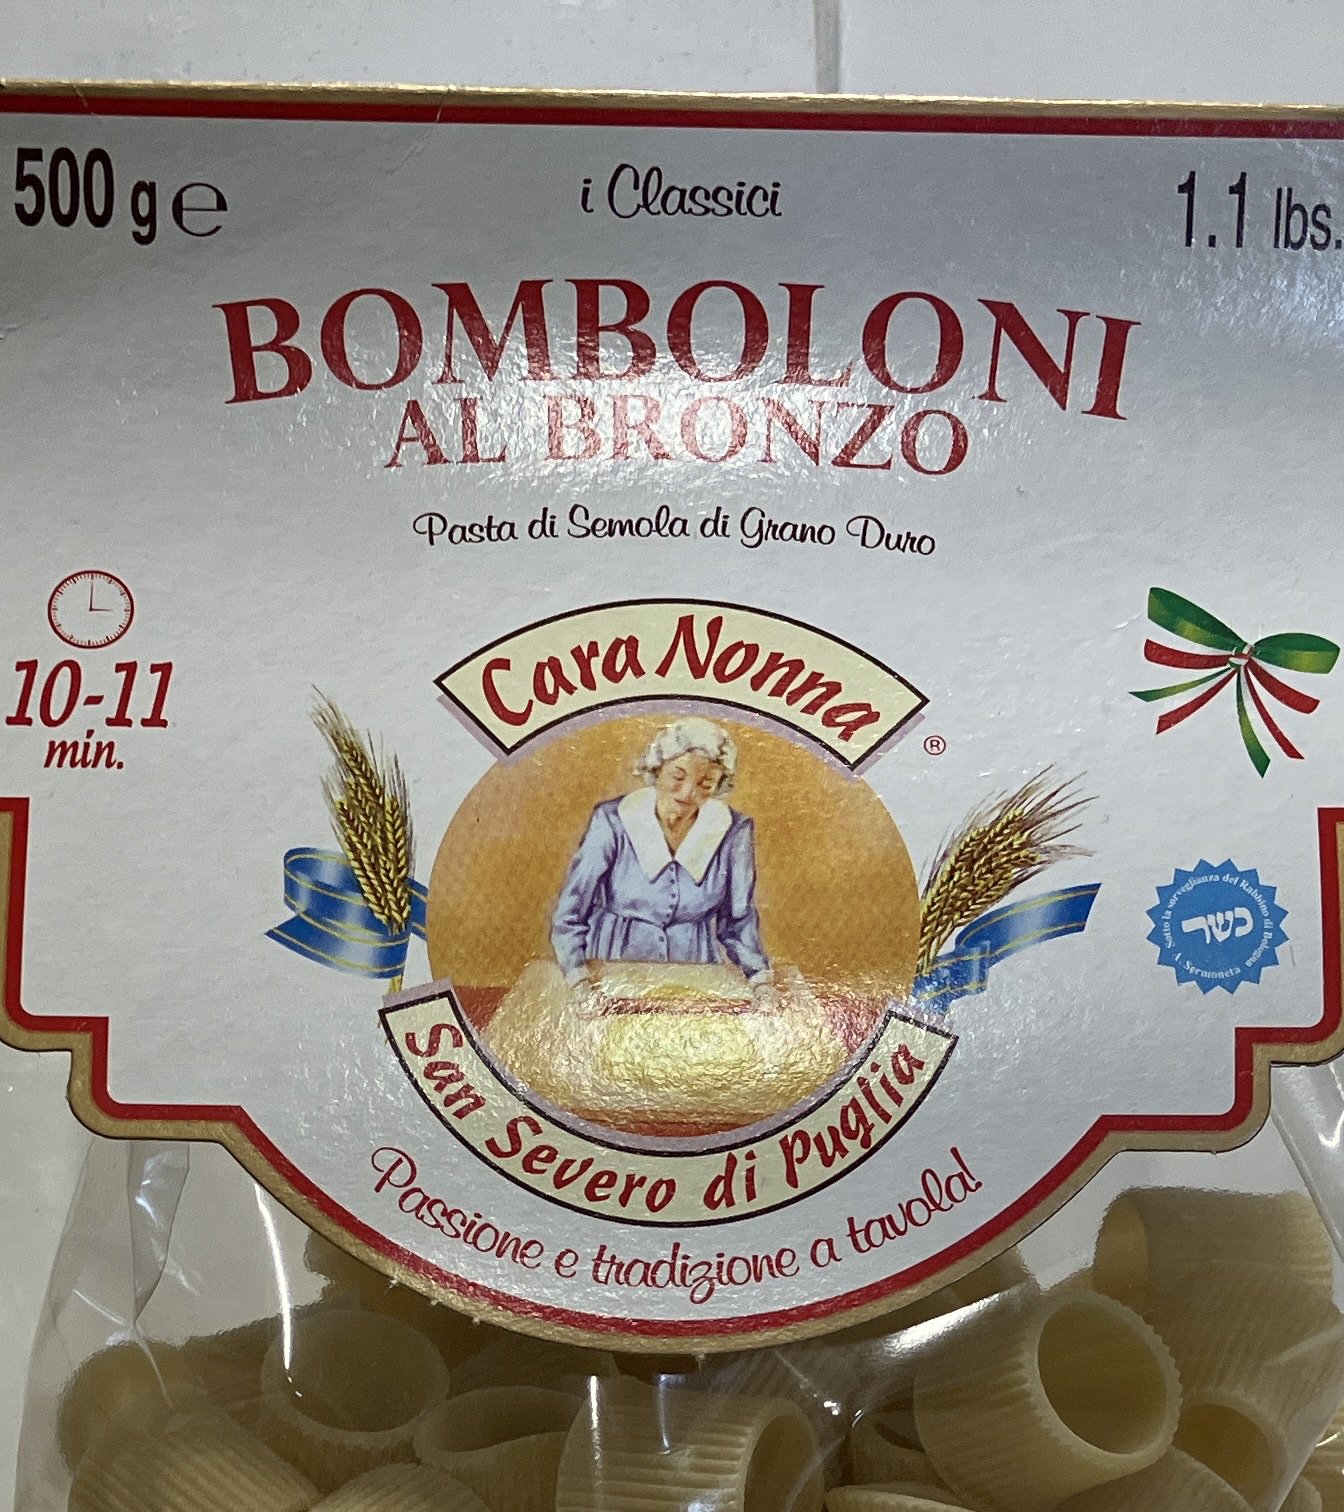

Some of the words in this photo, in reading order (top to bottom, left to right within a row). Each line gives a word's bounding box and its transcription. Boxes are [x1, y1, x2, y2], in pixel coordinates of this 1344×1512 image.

[13, 146, 115, 229] 500
[130, 179, 157, 246] g
[580, 177, 594, 213] i
[607, 163, 783, 219] Classici
[1177, 170, 1248, 248] 1.1
[1273, 186, 1343, 250] lbs.
[212, 279, 1141, 421] BOMBOLONI
[384, 397, 507, 469] AL
[543, 395, 969, 476] BRONZO
[413, 512, 519, 546] Pasta
[528, 507, 559, 539] di
[566, 504, 690, 540] Semola
[699, 507, 730, 539] di
[740, 507, 836, 549] Grano
[845, 515, 936, 556] Duro
[5, 658, 173, 730] 10-11
[481, 635, 646, 727] Cara
[655, 614, 882, 742] Nonna
[43, 729, 125, 770] min.
[1168, 874, 1220, 909] sorveglianza
[1222, 873, 1239, 885] del
[1239, 879, 1269, 917] Rabbino
[1161, 910, 1172, 920] la
[1162, 922, 1175, 948] Sotto
[1181, 906, 1254, 944] כשר
[406, 1021, 487, 1119] San
[486, 1115, 676, 1212] Severo
[704, 1150, 758, 1211] di
[784, 1042, 927, 1188] Puglia
[370, 1146, 543, 1270] Passione
[556, 1249, 578, 1279] e
[592, 1242, 798, 1305] tradizione
[810, 1237, 841, 1266] a
[847, 1148, 984, 1251] tavola!
